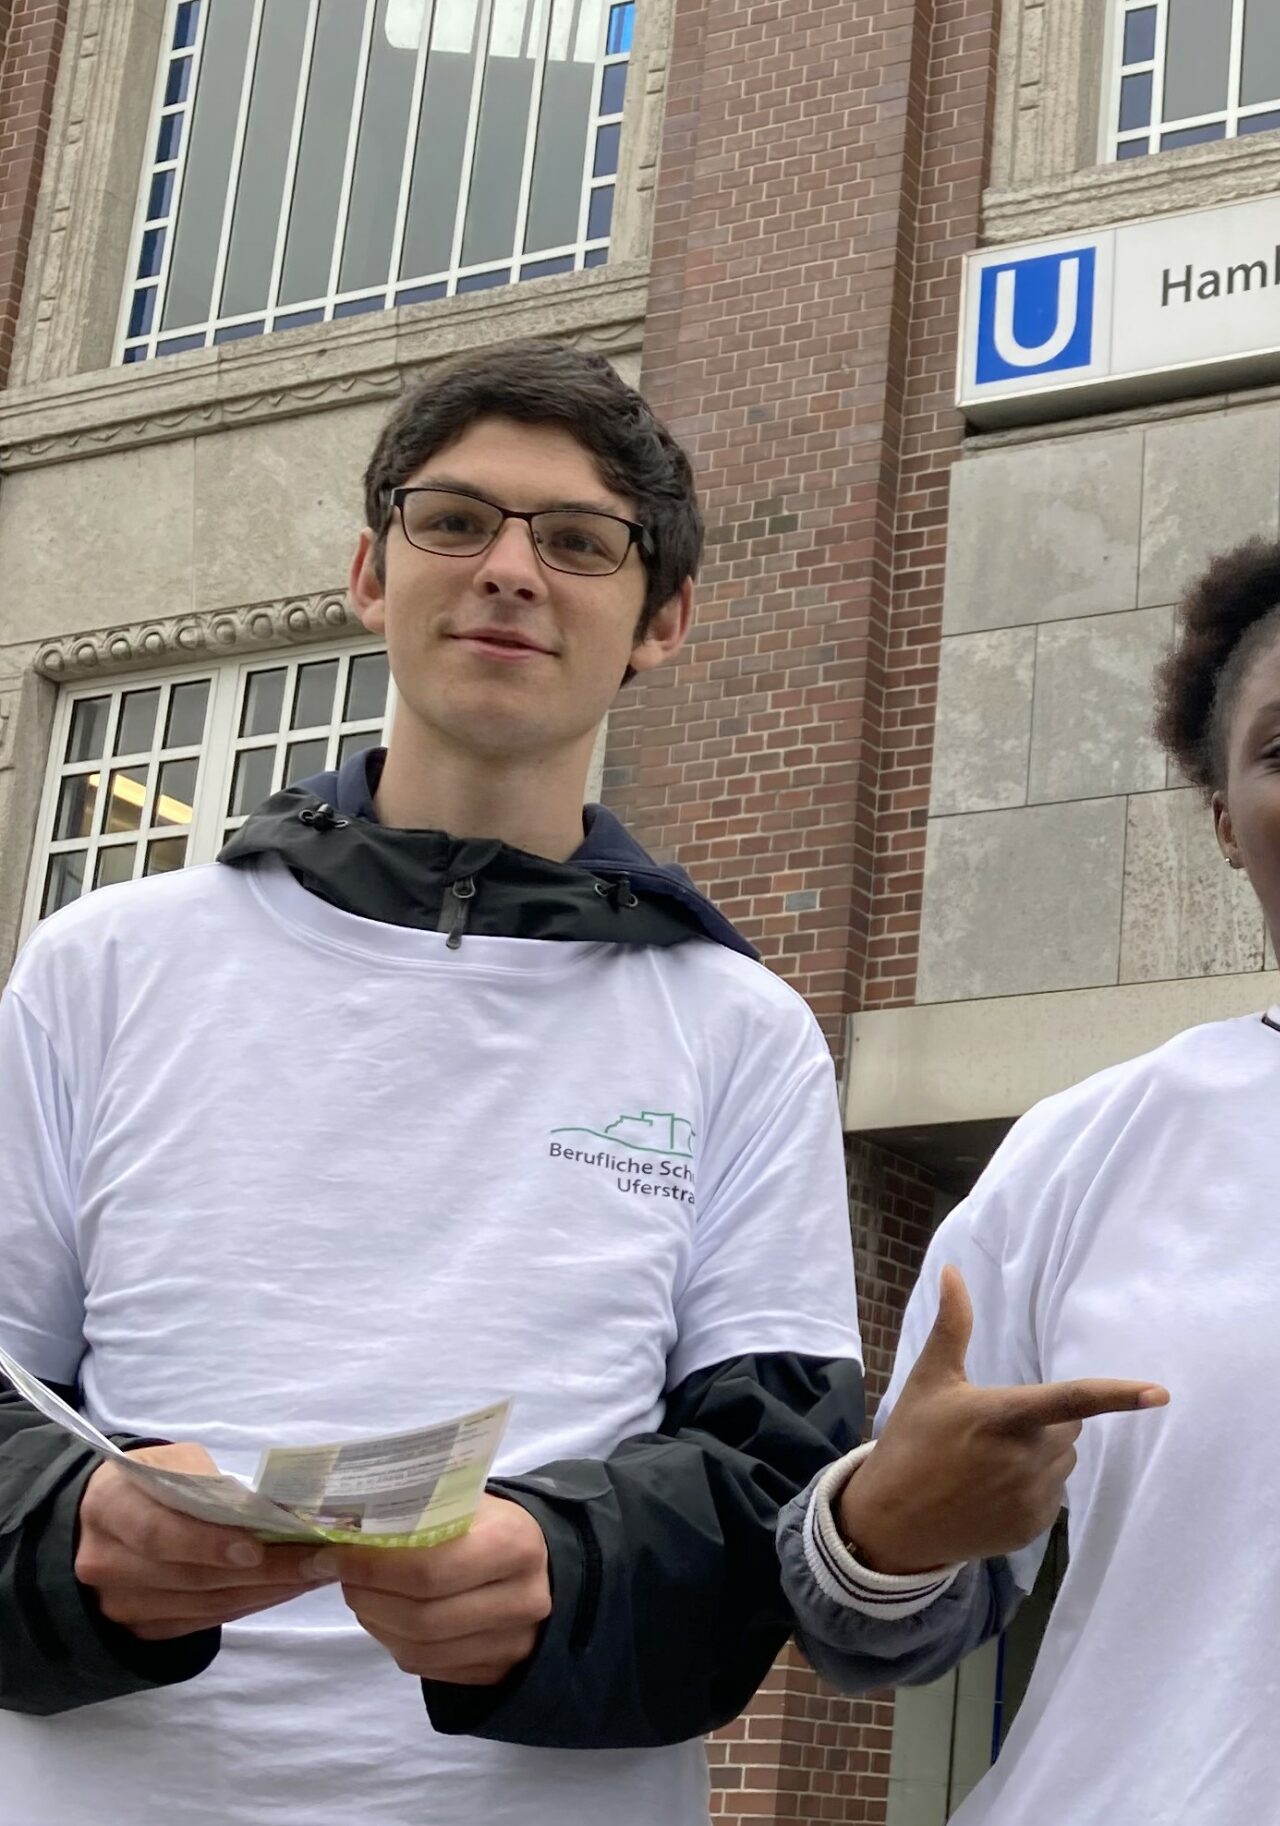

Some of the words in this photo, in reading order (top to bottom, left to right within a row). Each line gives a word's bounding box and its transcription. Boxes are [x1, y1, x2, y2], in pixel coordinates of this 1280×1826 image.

[995, 257, 1081, 368] U
[549, 1142, 653, 1175] Berufliche
[659, 1160, 695, 1183] Sch
